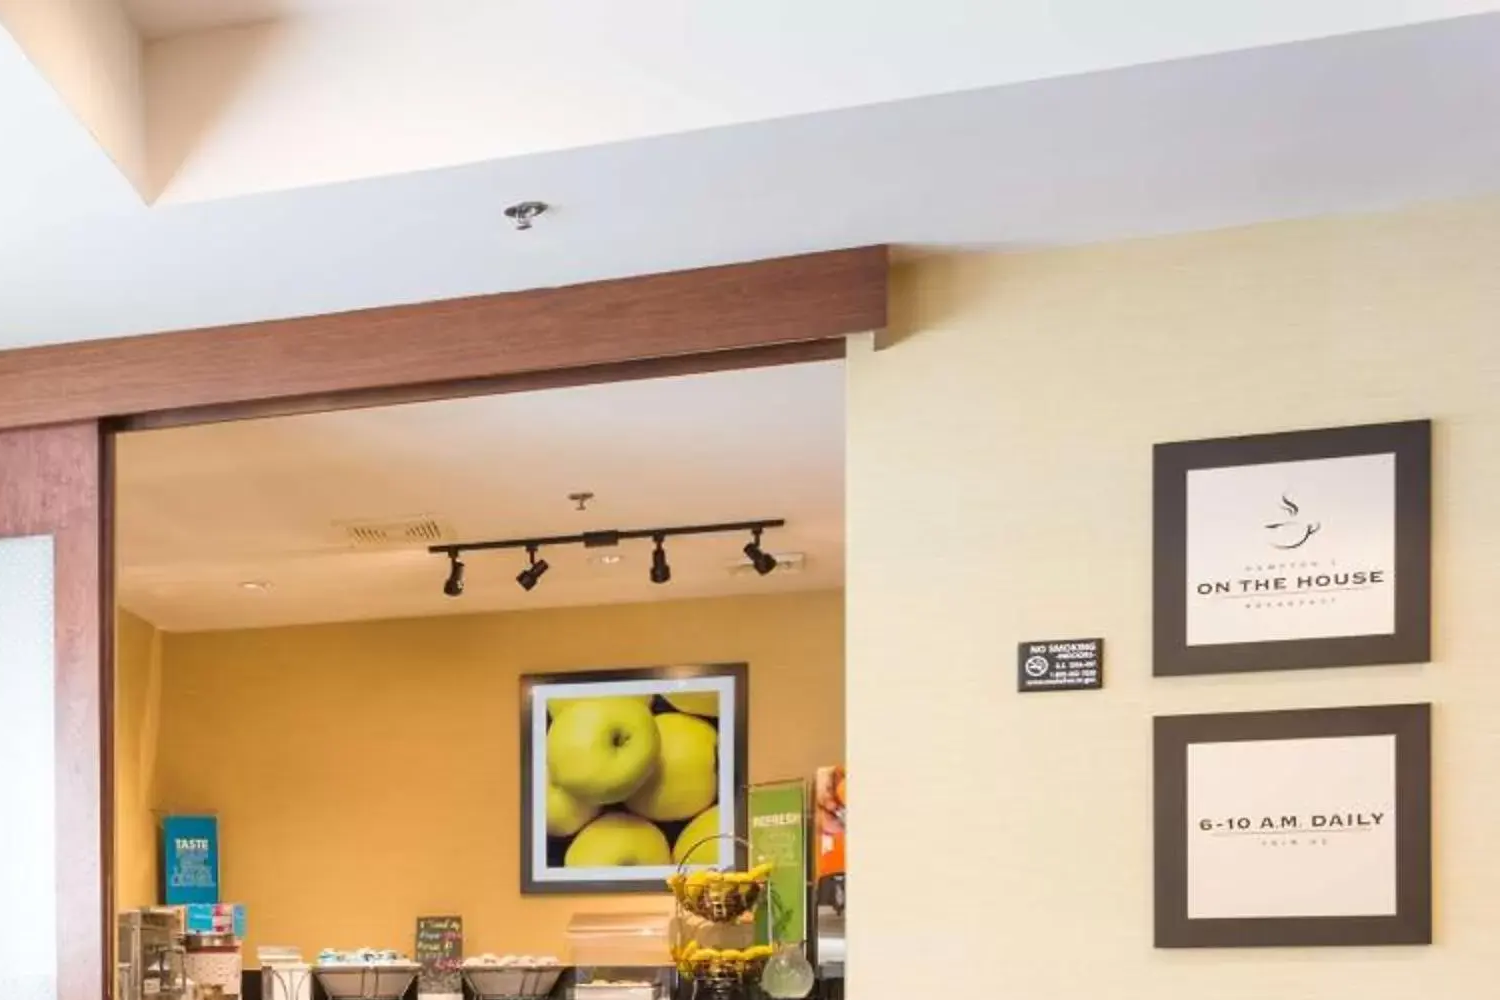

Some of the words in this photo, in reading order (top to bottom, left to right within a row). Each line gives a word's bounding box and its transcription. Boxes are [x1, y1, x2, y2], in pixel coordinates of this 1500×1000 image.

[1197, 581, 1231, 595] ON
[1240, 577, 1287, 592] THE
[1297, 570, 1385, 588] HOUSE
[1030, 645, 1047, 654] NO
[1199, 817, 1251, 831] 6-10
[1311, 812, 1384, 828] DAILY
[174, 838, 209, 849] TASTE
